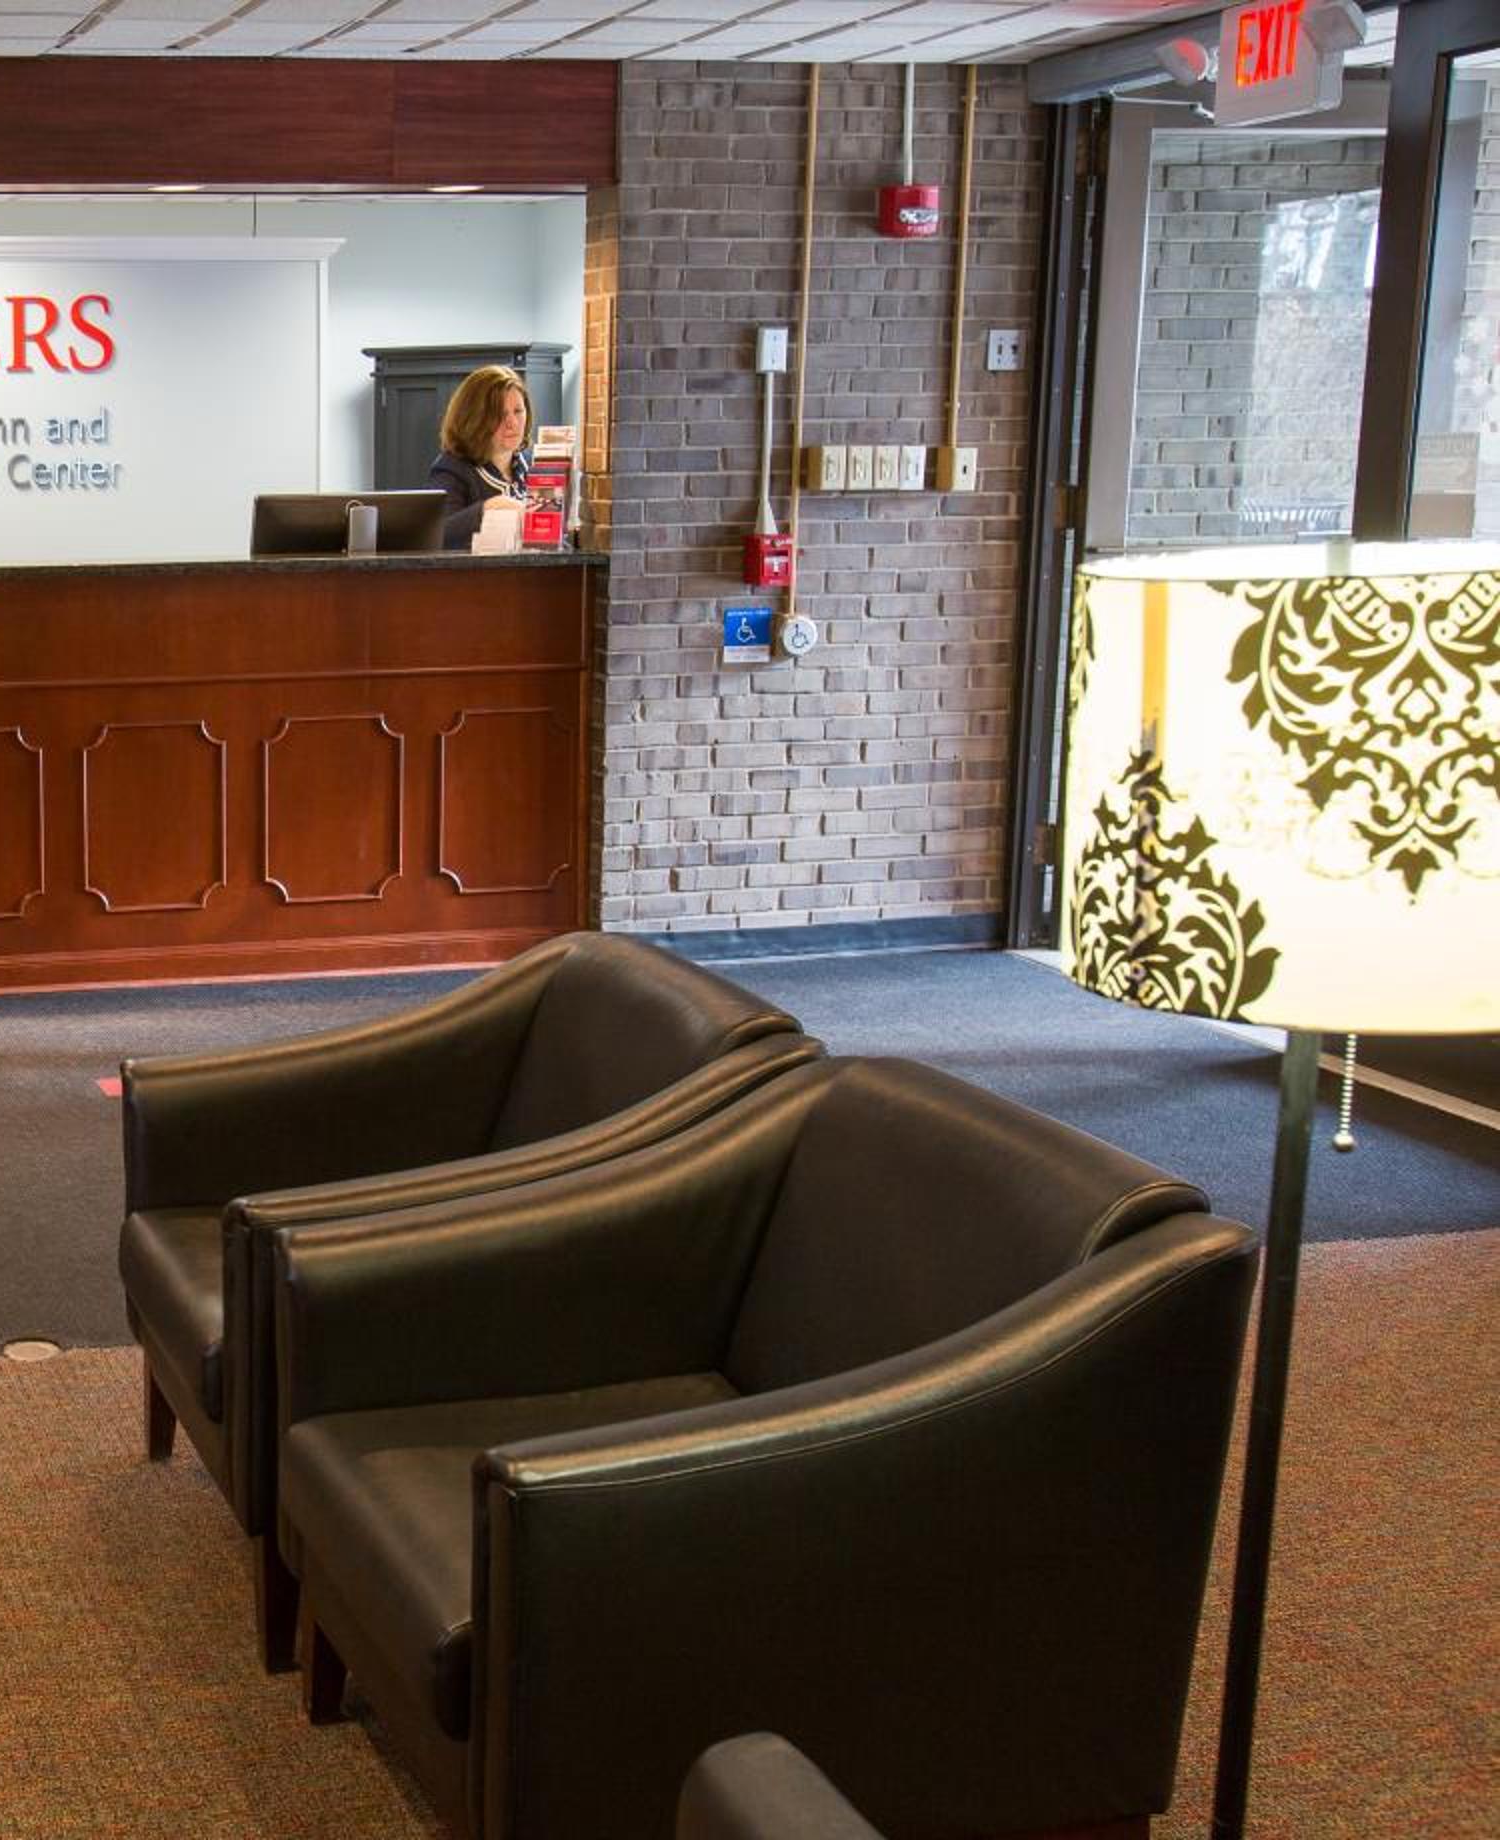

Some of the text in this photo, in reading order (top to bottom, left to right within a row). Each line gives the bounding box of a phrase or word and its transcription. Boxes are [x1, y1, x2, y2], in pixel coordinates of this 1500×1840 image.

[1236, 0, 1307, 87] EXIT
[44, 407, 111, 445] and
[7, 452, 123, 491] Center
